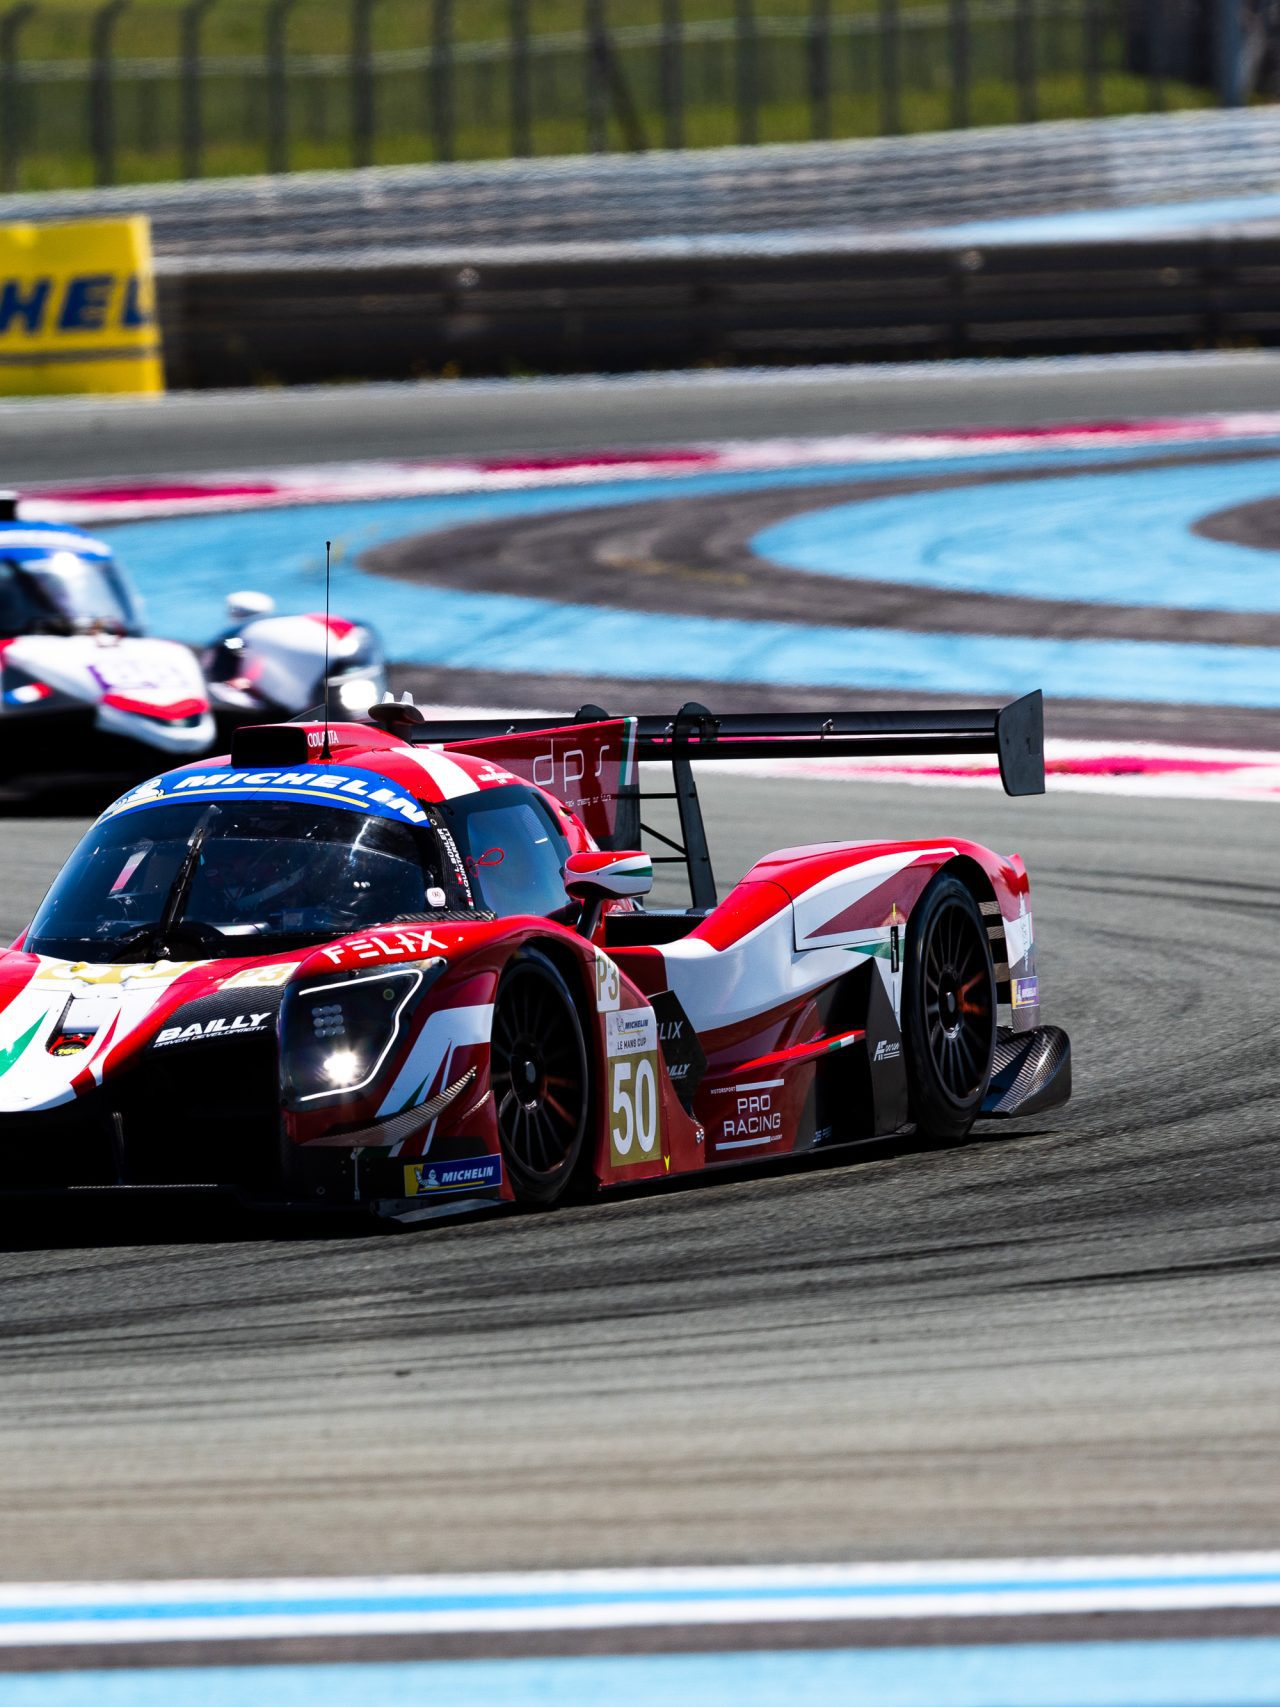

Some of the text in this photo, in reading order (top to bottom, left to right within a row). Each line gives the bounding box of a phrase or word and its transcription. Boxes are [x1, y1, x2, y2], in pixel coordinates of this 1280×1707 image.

[533, 738, 610, 792] dps
[173, 772, 427, 823] MICHELIN
[321, 930, 449, 964] FELIX
[227, 964, 290, 985] P3
[597, 956, 618, 1001] P3
[155, 1012, 272, 1043] BAILLY
[624, 1020, 648, 1030] MICHELIN
[657, 1021, 683, 1040] LIX
[153, 1025, 268, 1048] DRIVER DEVELOPMENT
[617, 1038, 647, 1050] LE MANS CUP
[666, 1064, 691, 1077] ILLY
[710, 1086, 736, 1094] MOTORSPORT
[613, 1059, 657, 1155] 50
[737, 1094, 771, 1114] PRO
[723, 1113, 781, 1137] RACING
[442, 1166, 493, 1182] MICHELIN
